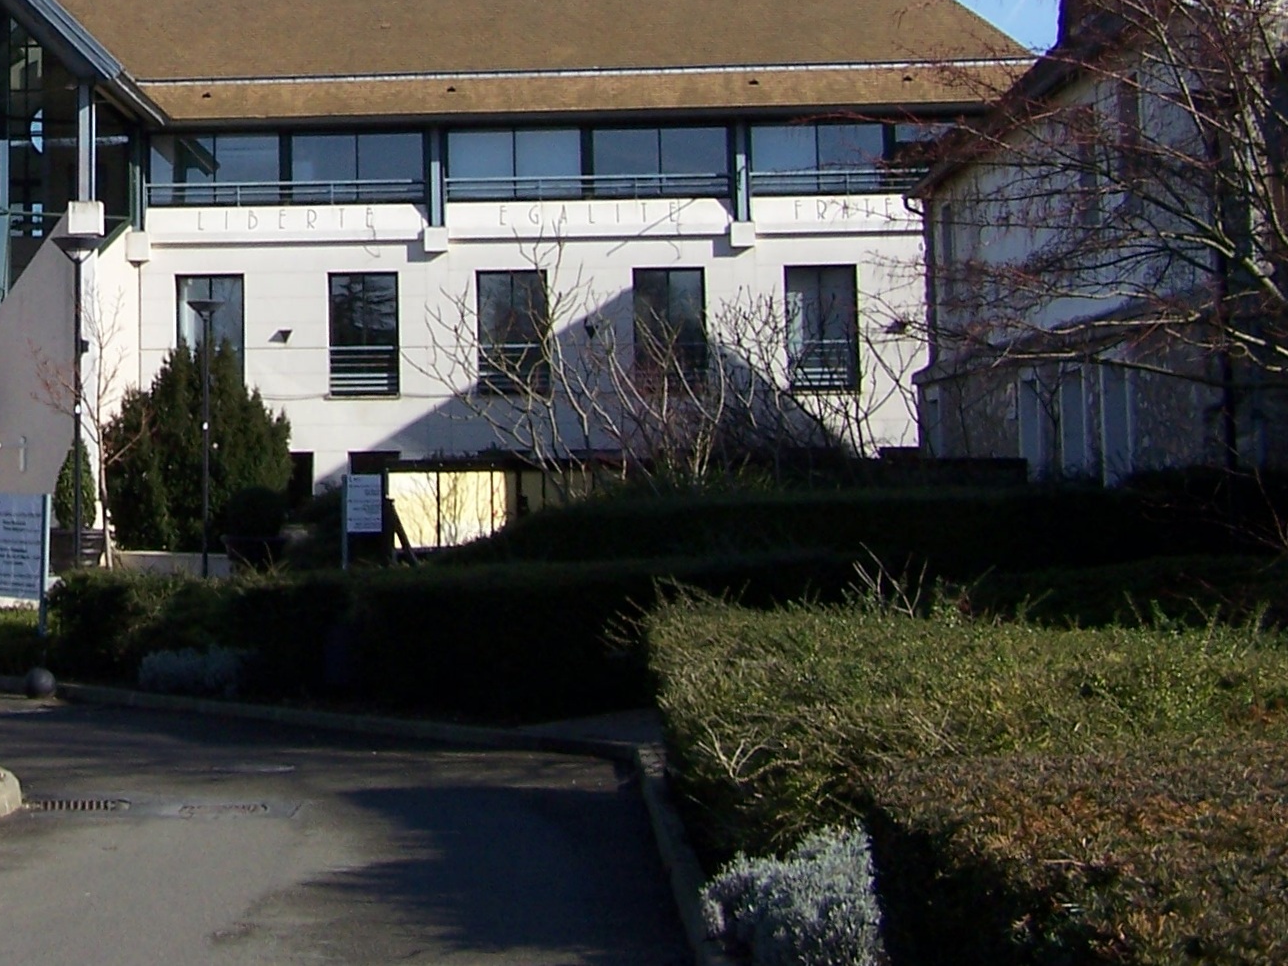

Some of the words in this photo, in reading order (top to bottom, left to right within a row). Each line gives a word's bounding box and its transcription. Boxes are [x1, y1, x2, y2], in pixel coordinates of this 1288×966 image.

[197, 207, 373, 231] LIBERTE
[499, 201, 677, 225] EGALITE
[793, 197, 893, 221] FRATE
